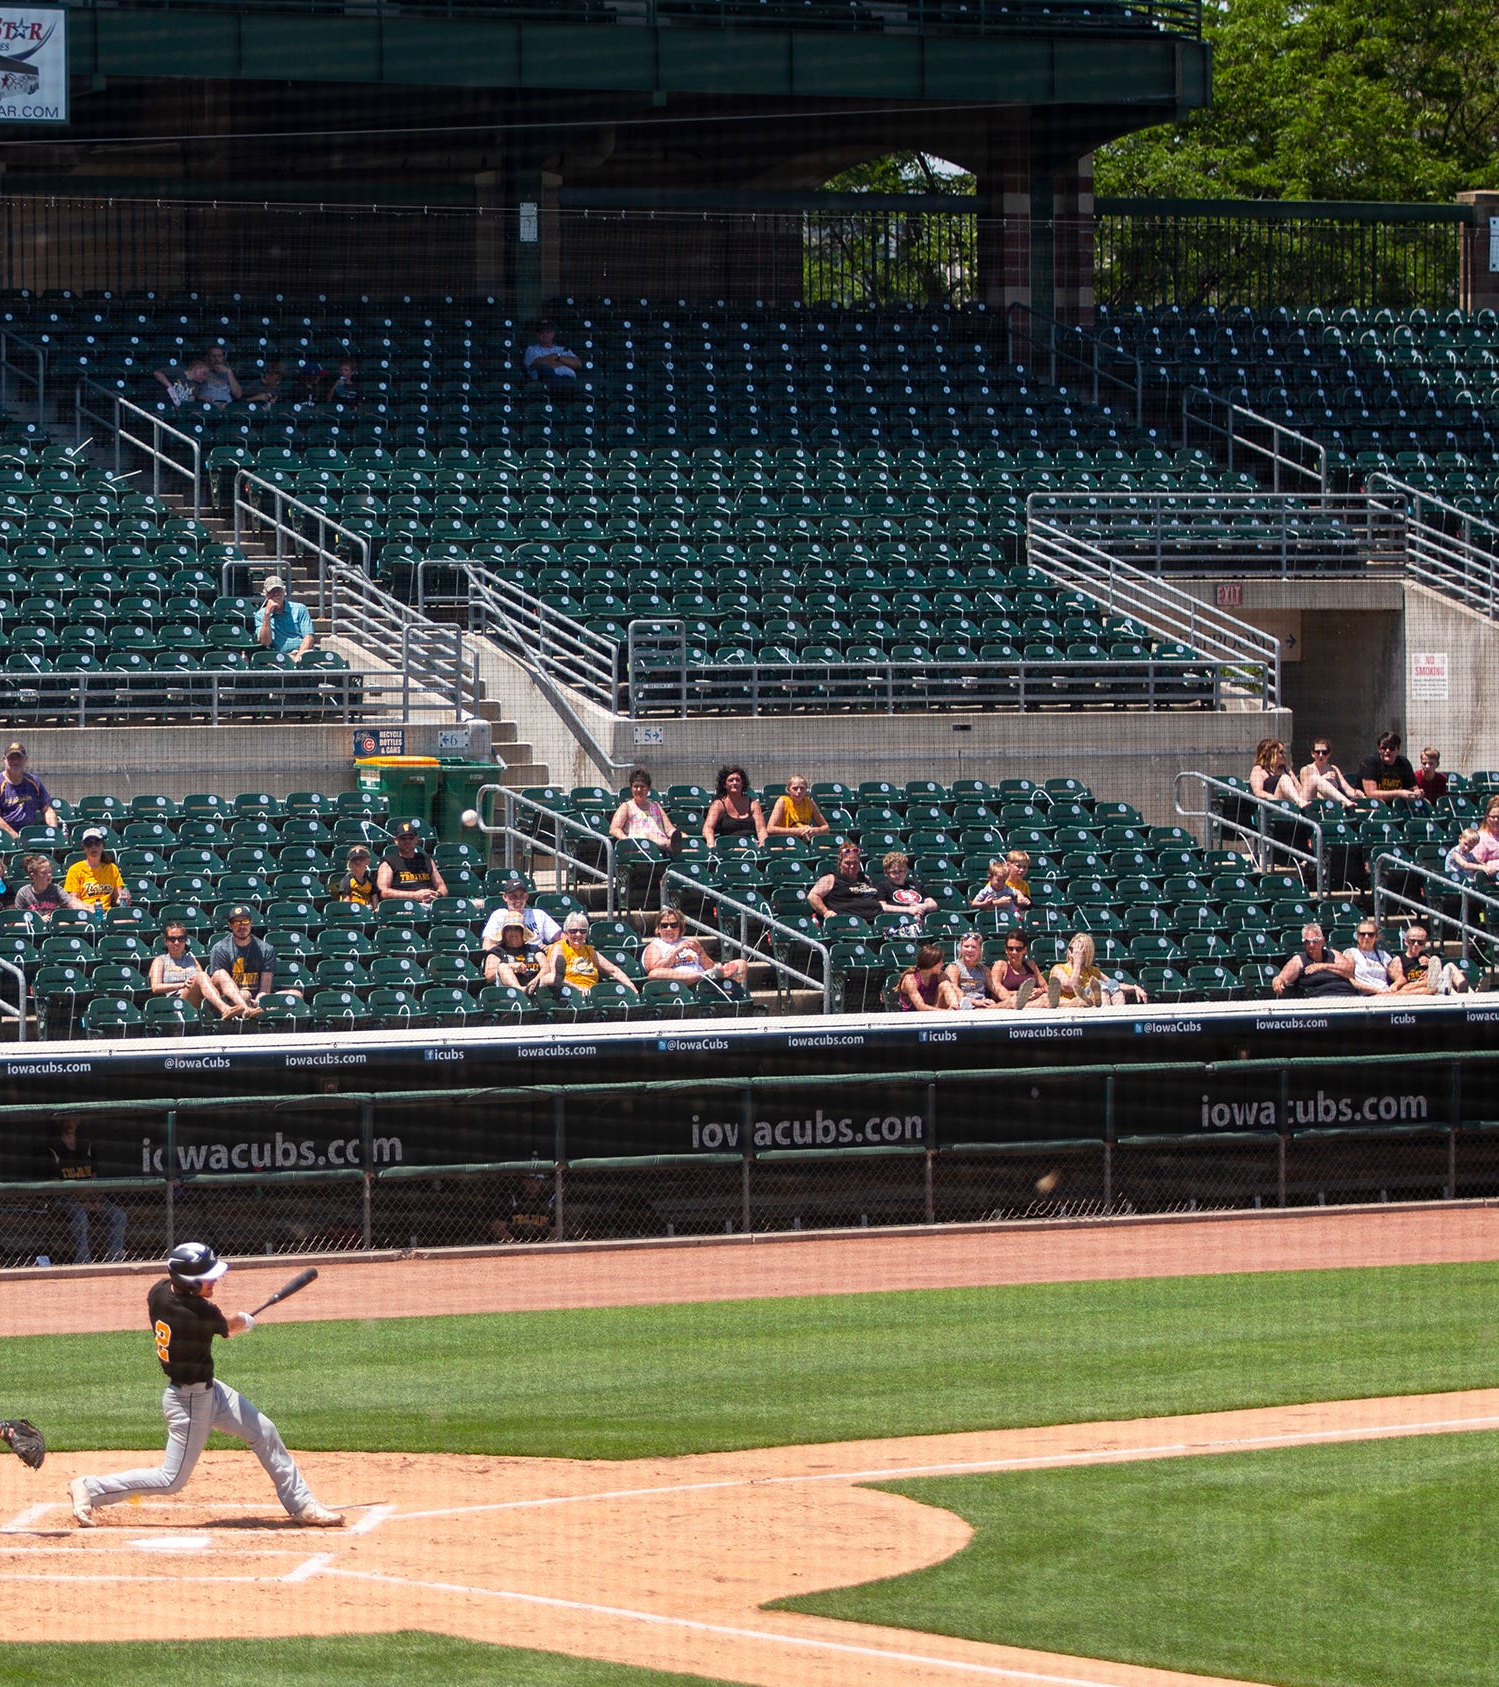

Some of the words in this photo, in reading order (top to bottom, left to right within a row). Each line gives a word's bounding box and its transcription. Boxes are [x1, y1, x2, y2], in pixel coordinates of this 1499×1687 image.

[450, 734, 458, 745] 6
[644, 729, 652, 741] 5
[7, 1061, 91, 1075] iowacubs.com
[164, 1056, 230, 1070] @IowaCubs
[286, 1053, 367, 1066] iowacubs.com
[434, 1049, 464, 1061] icubs
[517, 1045, 596, 1057] iowacubs.com
[667, 1038, 728, 1051] @IowaCubs
[788, 1034, 864, 1047] iowacubs.com
[928, 1030, 957, 1042] icubs
[1009, 1026, 1083, 1039] iowacubs.com
[1143, 1021, 1201, 1034] @IowaCubs
[1256, 1017, 1328, 1030] iowacubs.com
[1390, 1013, 1416, 1025] icubs
[155, 1319, 171, 1362] 2
